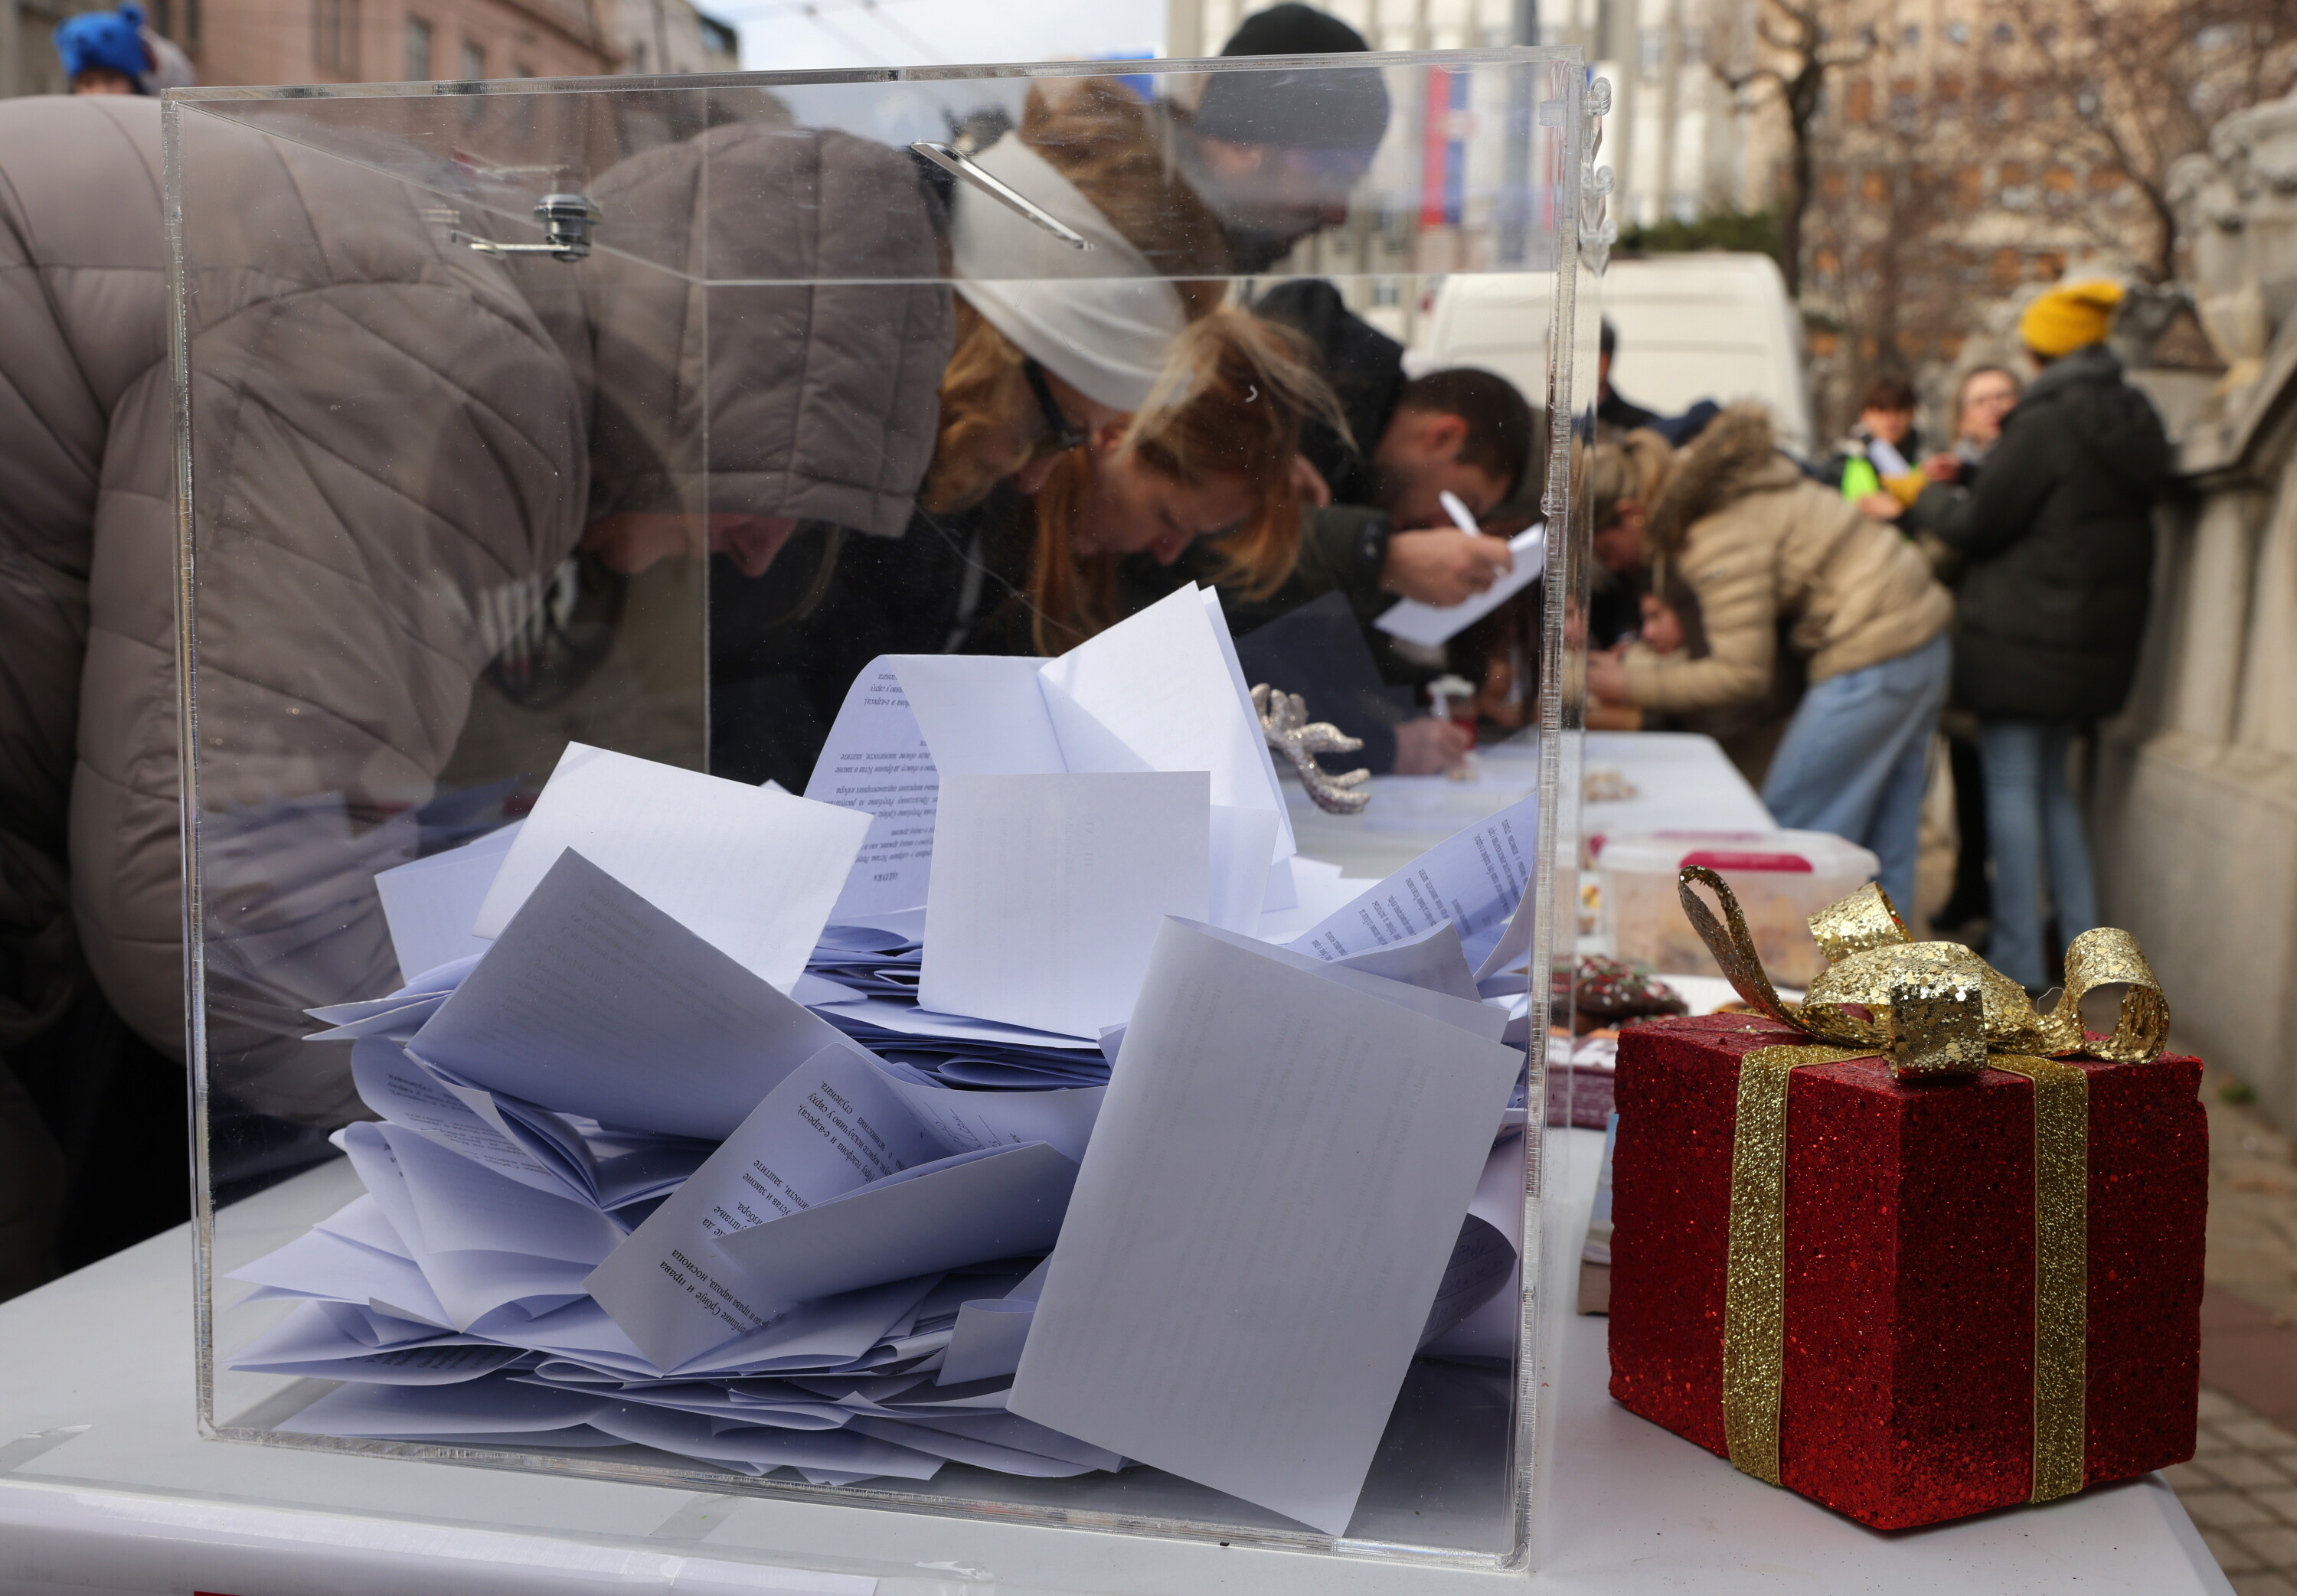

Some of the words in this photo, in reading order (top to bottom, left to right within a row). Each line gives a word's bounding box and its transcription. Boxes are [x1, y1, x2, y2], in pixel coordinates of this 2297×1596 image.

[807, 1092, 828, 1113] сврху
[820, 1081, 853, 1115] студената.
[797, 1104, 830, 1137] е-адреса),
[826, 1110, 836, 1119] у
[829, 1136, 837, 1144] и
[832, 1116, 865, 1149] искључиво
[837, 1142, 862, 1169] телефона
[742, 1173, 767, 1196] законе
[753, 1160, 783, 1187] заштите
[859, 1164, 875, 1183] (број
[765, 1193, 773, 1201] и
[772, 1198, 791, 1219] Устав
[702, 1218, 716, 1229] да
[737, 1201, 763, 1229] избора.
[660, 1261, 687, 1286] права
[671, 1249, 708, 1282] носиоца
[686, 1284, 695, 1293] и
[709, 1278, 734, 1303] народа,
[695, 1291, 720, 1316] Србије
[732, 1299, 751, 1317] права
